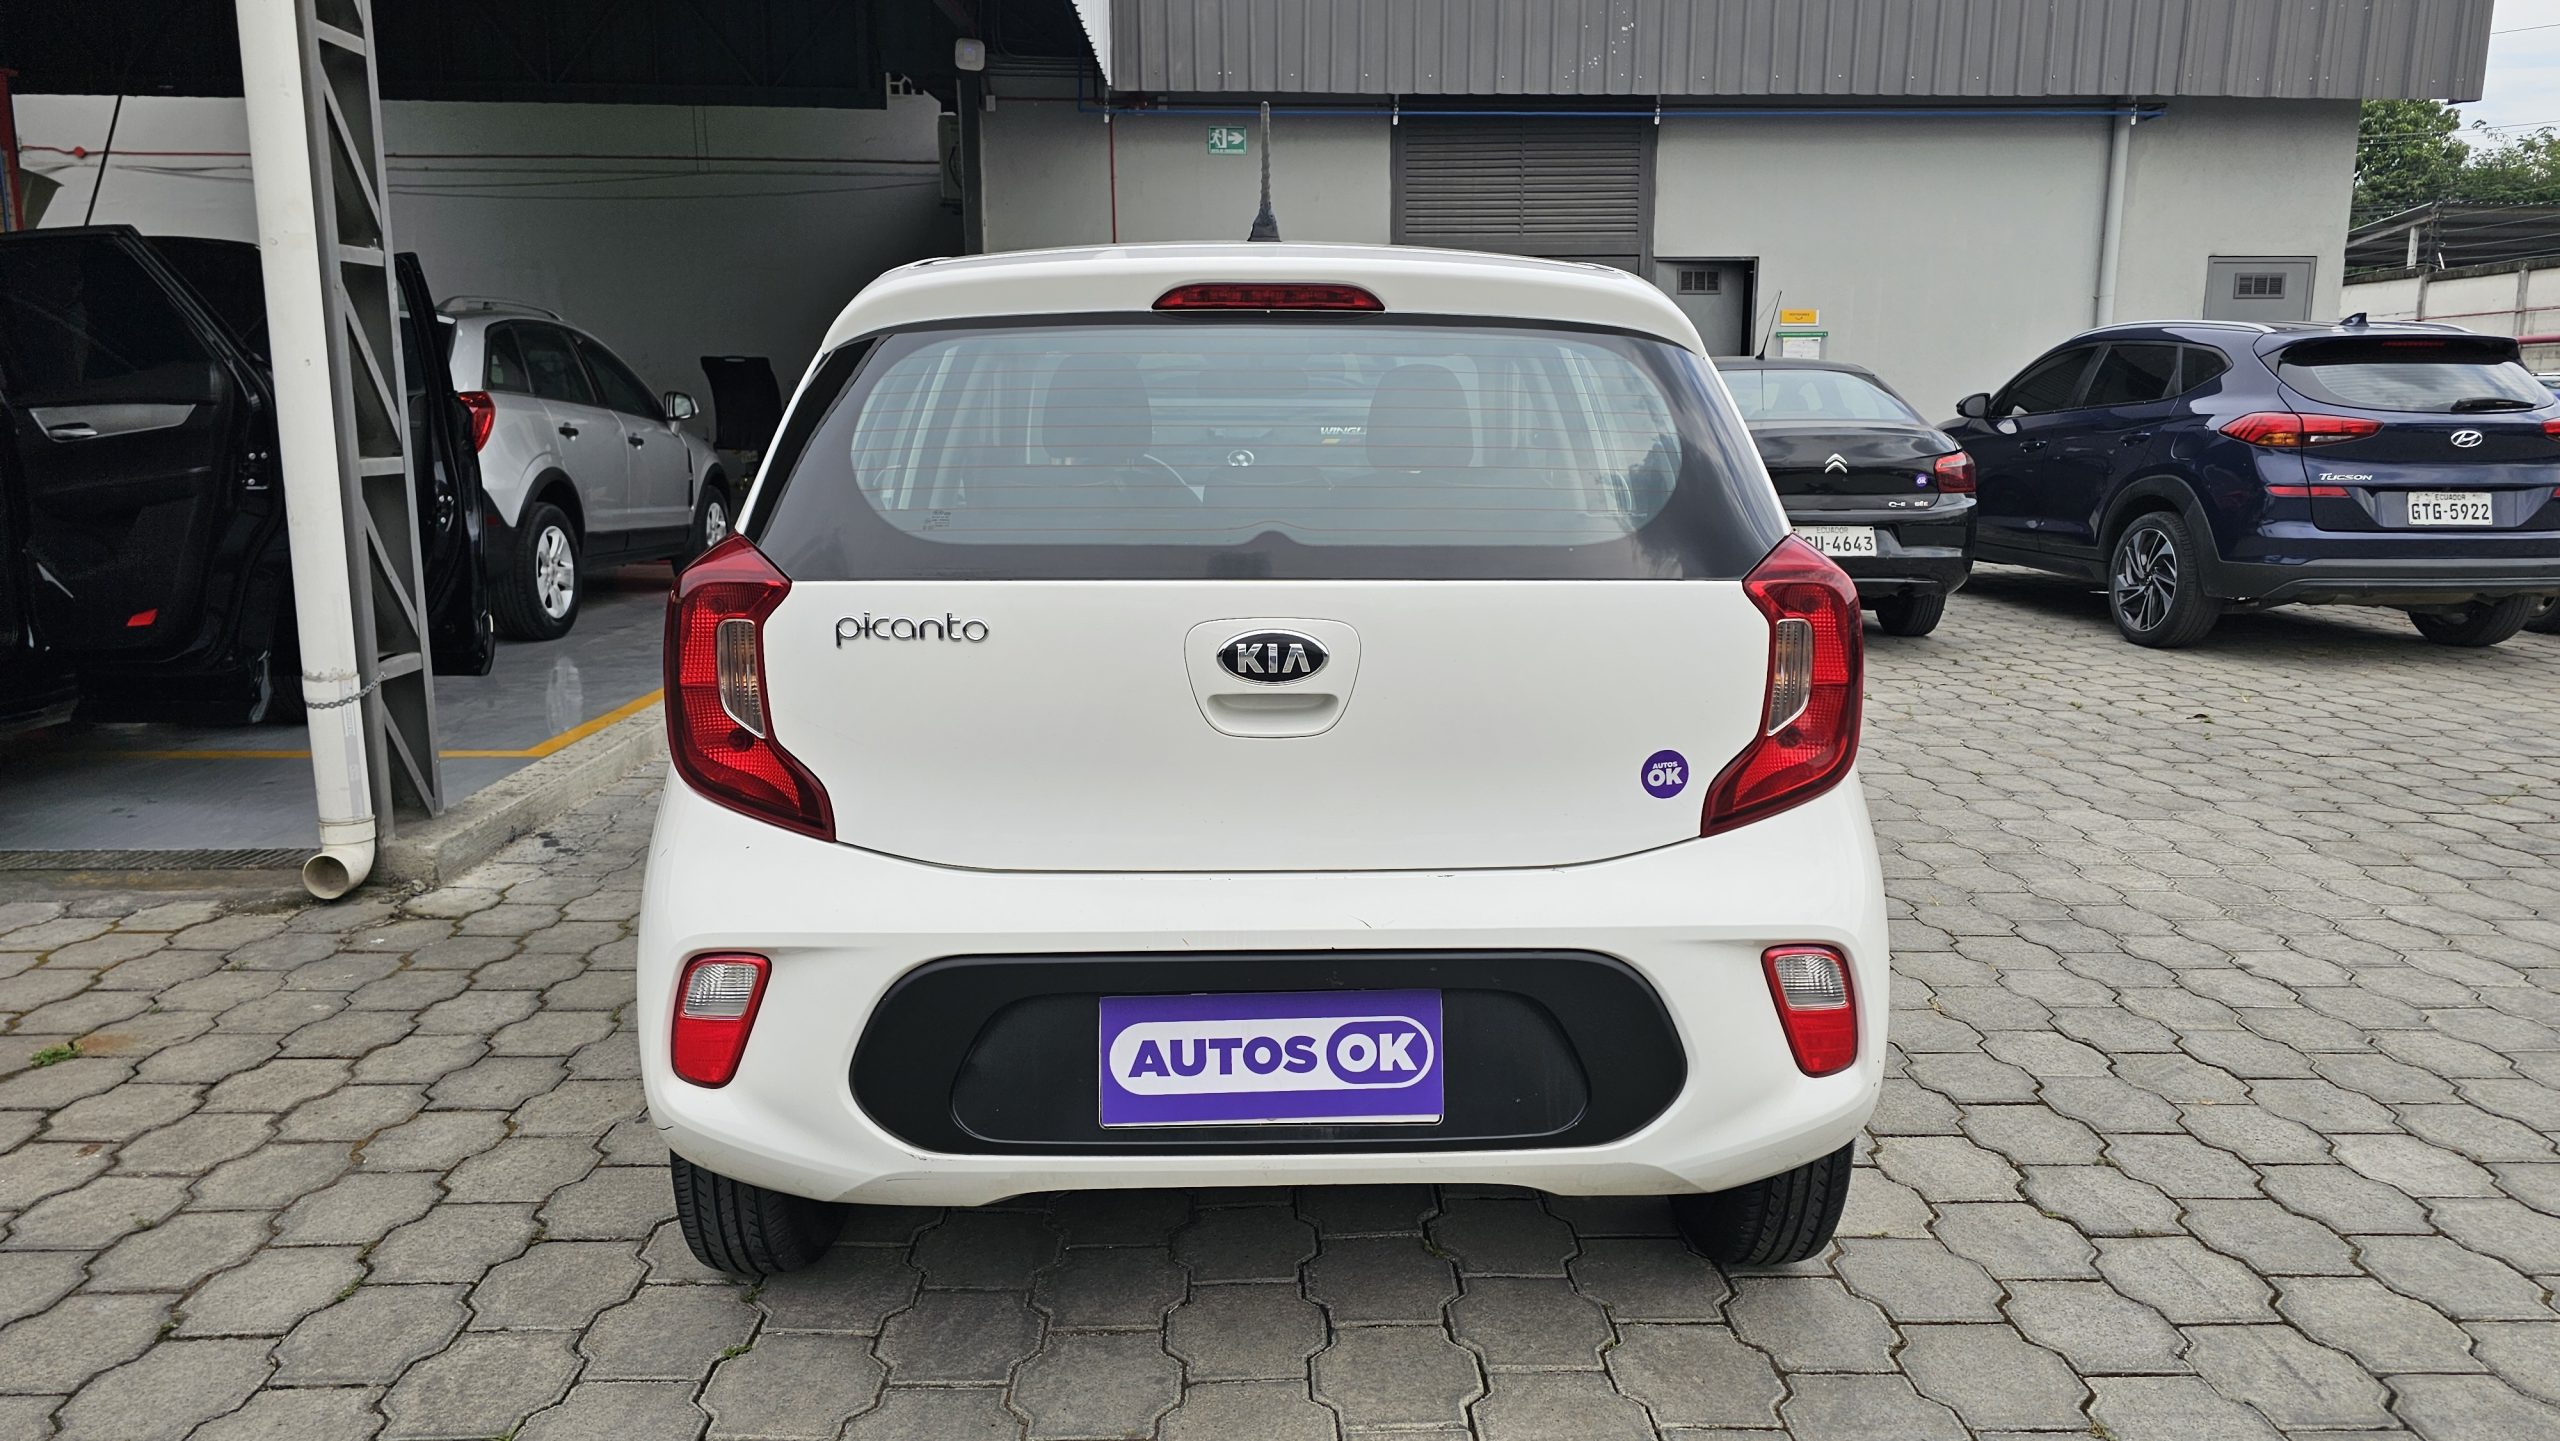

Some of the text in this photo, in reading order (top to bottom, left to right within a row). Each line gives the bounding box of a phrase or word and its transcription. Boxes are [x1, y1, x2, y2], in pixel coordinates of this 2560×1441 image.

[1320, 426, 1367, 435] WINGL
[2319, 472, 2373, 481] TUCSON
[2434, 493, 2466, 501] ECUADOR
[2411, 503, 2490, 521] GTG-5922
[1816, 526, 1849, 534] ECUADOR
[1804, 535, 1874, 552] U-4643
[836, 610, 989, 649] picanto
[1236, 643, 1311, 674] KIA
[1652, 761, 1678, 770] AUTOS
[1647, 766, 1683, 787] OK
[1128, 1032, 1417, 1078] AUTOS OK
